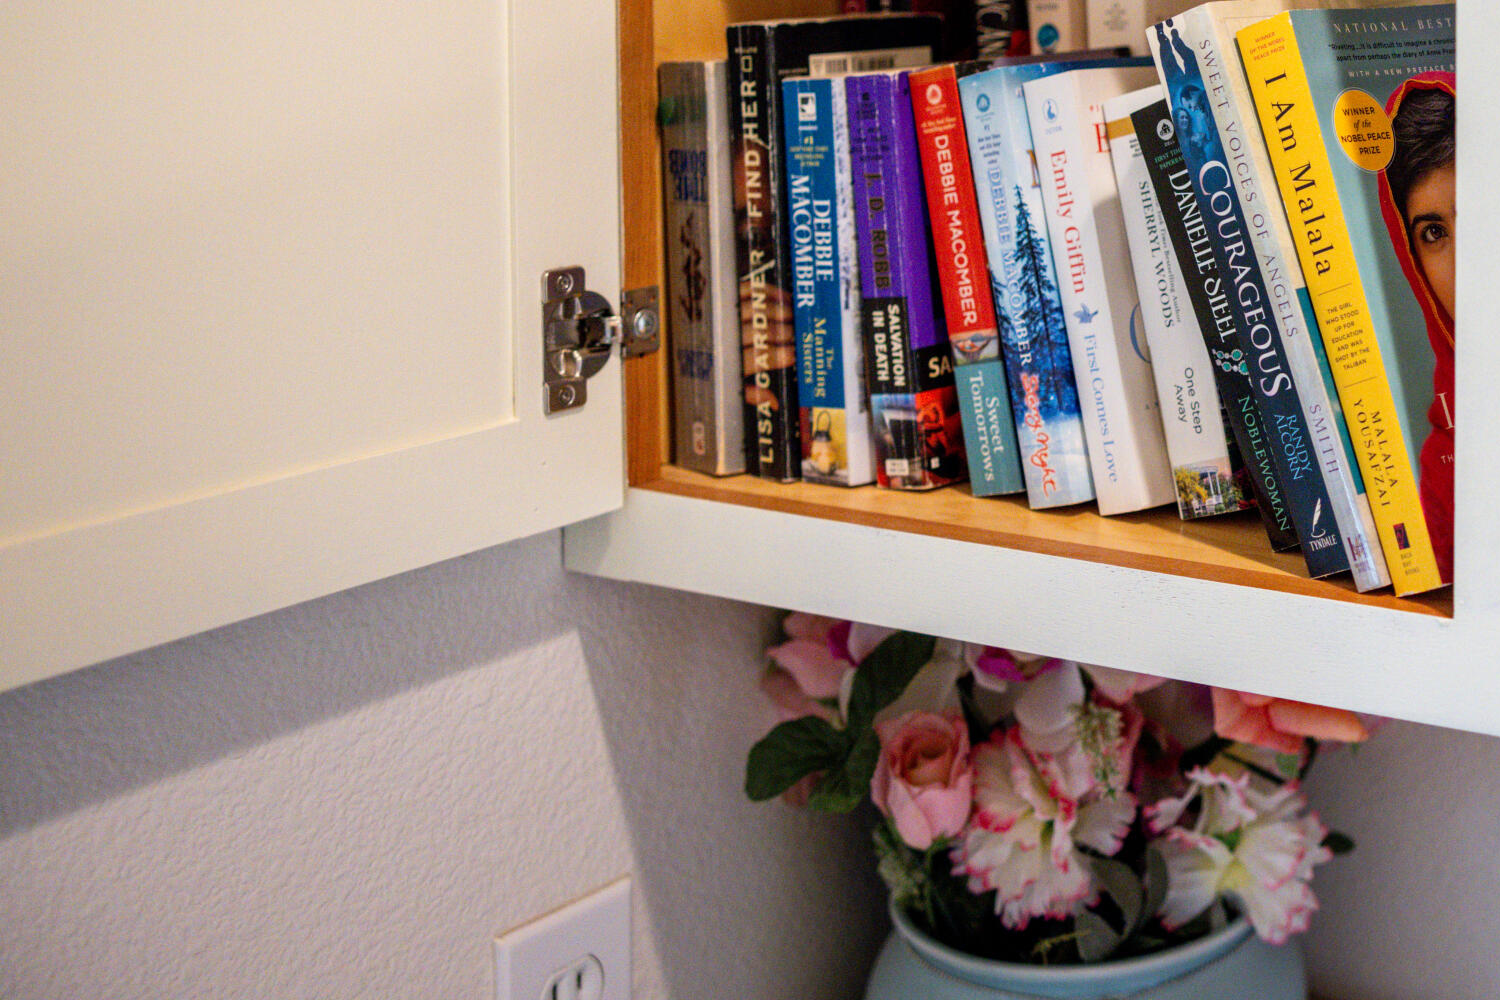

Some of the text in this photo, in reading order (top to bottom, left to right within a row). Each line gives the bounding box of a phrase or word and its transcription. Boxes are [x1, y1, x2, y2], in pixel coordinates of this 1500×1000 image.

[1333, 21, 1409, 34] NATIONAL
[1406, 64, 1444, 73] PREFACE
[741, 80, 770, 218] FIND HER
[1341, 132, 1391, 144] NOBEL PEACE
[1342, 107, 1375, 117] WINNER
[1362, 118, 1372, 128] the
[935, 134, 960, 204] DEBBIE
[1264, 71, 1334, 276] I Am Malala
[1359, 146, 1381, 156] PRIZE
[1050, 149, 1075, 220] Emily
[1064, 226, 1086, 294] Giffin
[1199, 39, 1299, 339] SWEET VOICES OF ANGELS
[790, 174, 816, 308] MACOMBER
[813, 199, 834, 282] DEBBIE
[870, 229, 890, 290] ROBB
[946, 207, 978, 327] MACOMBER
[988, 167, 1012, 244] DEBBIE
[1002, 249, 1032, 366] MACOMBER
[1138, 180, 1175, 329] SHERRYL WOODS
[1168, 169, 1236, 343] DANIELLE STEEL
[1199, 159, 1292, 398] COURAGEOUS
[750, 250, 774, 464] LISA GARDNER
[802, 333, 813, 385] Sisters
[813, 317, 827, 399] Manning
[872, 310, 890, 382] IN DEATH
[887, 304, 906, 387] SALVATION
[1331, 329, 1363, 344] EDUCATION
[1343, 359, 1367, 370] TALIBAN
[969, 370, 995, 482] Tomorrows
[984, 396, 1004, 453] Sweet
[1083, 334, 1119, 483] First Comes Love
[1174, 384, 1188, 423] Away
[1184, 367, 1203, 435] One Step
[1238, 395, 1290, 532] NOBLEWOMAN
[1273, 413, 1303, 481] ALCORN
[1286, 413, 1313, 473] RANDY
[1308, 403, 1339, 474] SMITH
[1353, 398, 1391, 507] YOUSAFZAI
[1370, 411, 1399, 488] MALALA
[1309, 534, 1338, 551] TYNDALE
